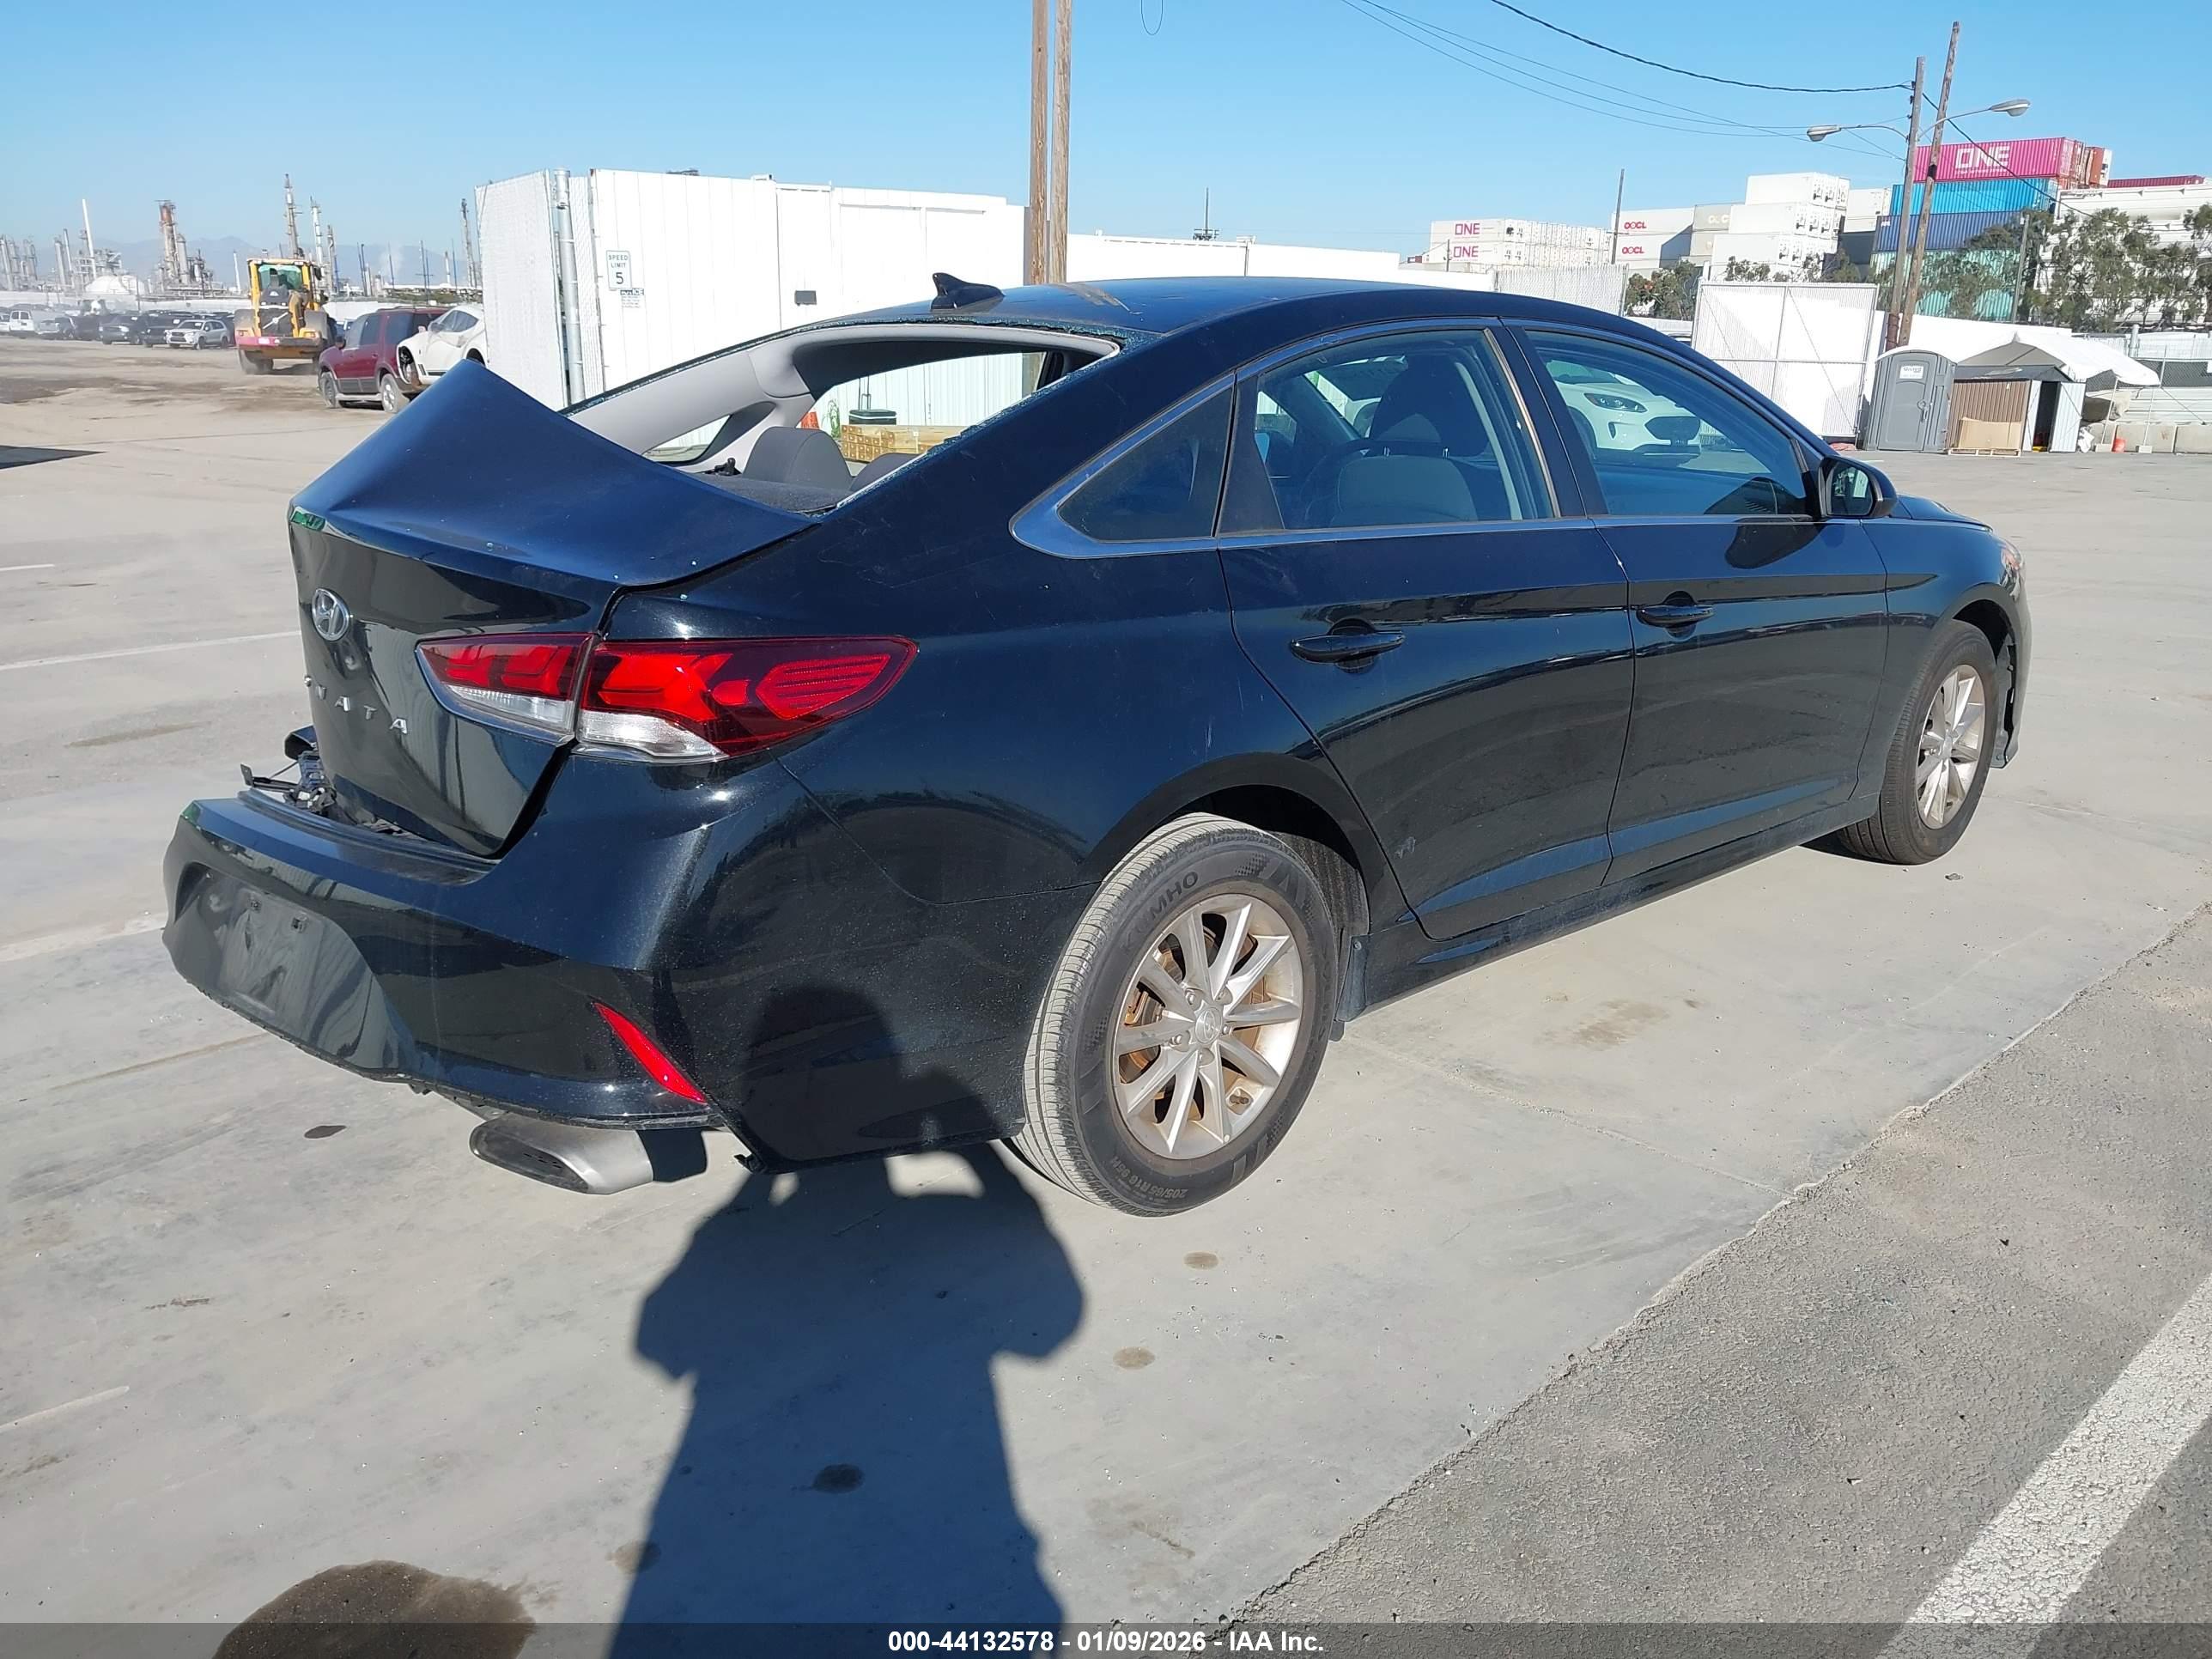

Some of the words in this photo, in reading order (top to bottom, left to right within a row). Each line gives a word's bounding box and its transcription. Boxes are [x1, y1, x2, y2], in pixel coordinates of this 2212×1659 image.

[1955, 146, 2010, 168] ONE
[1455, 222, 1480, 235] ONE
[1453, 246, 1479, 258] ONE
[616, 271, 623, 284] 5
[1149, 1184, 1188, 1199] 205/65
